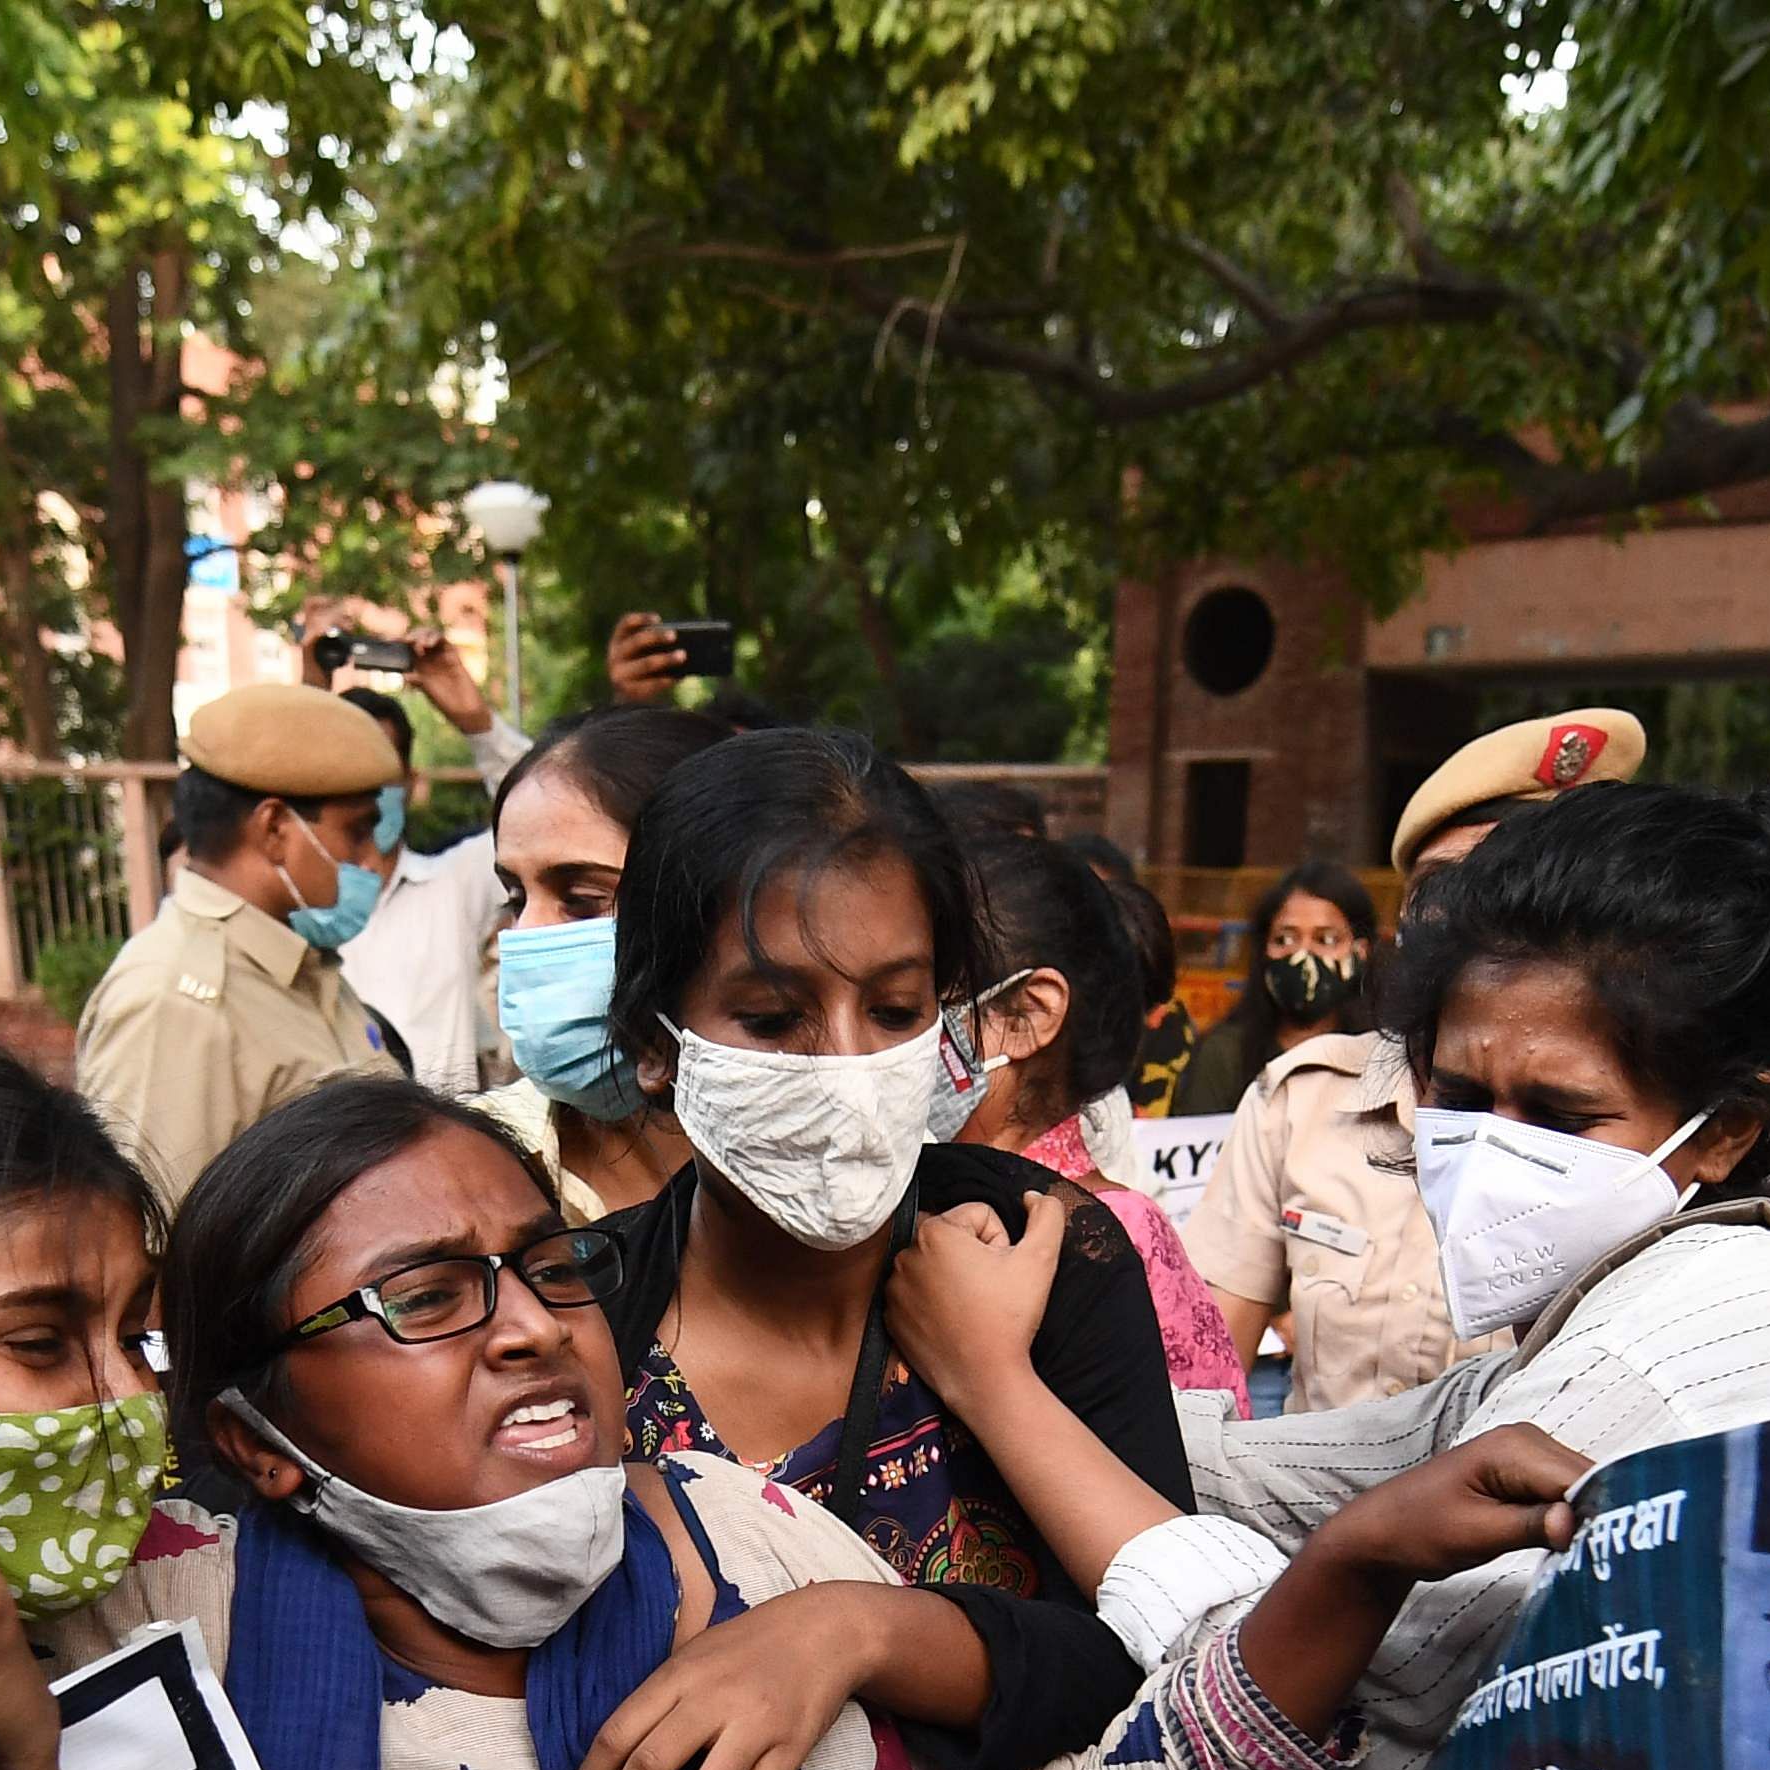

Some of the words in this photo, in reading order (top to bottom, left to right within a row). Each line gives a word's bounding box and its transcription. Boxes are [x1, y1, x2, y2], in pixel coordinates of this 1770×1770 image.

[1153, 1141, 1224, 1180] KY
[1485, 1260, 1567, 1295] KN95
[1587, 1489, 1689, 1582] सुरक्षा
[1534, 1650, 1586, 1705] गला
